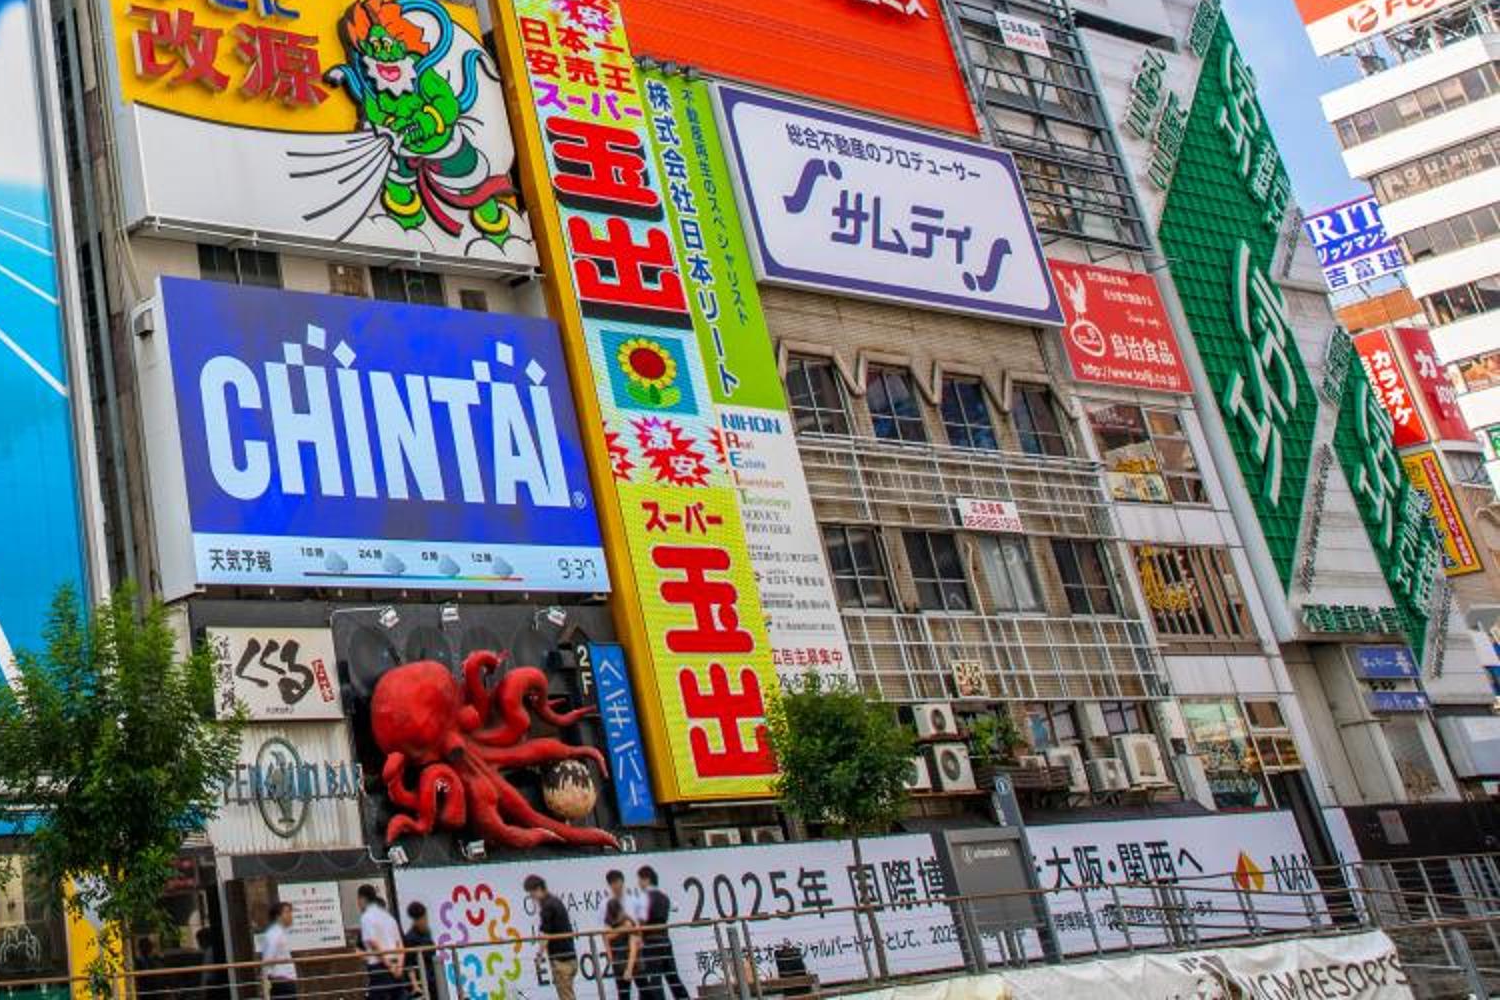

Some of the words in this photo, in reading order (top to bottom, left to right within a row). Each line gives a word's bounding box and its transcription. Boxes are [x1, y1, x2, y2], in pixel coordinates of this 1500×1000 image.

[126, 4, 332, 108] 改源
[520, 15, 626, 53] 日本一
[525, 48, 637, 95] 安売王
[532, 79, 644, 122] スーパー
[785, 121, 982, 184] 総合不動産のプロデューサー
[645, 79, 741, 400] 株式会社日本リート
[830, 188, 974, 268] サムティ
[199, 322, 572, 509] CHINTAI
[1371, 350, 1413, 425] カラオケ
[720, 412, 783, 435] NIHON
[641, 501, 724, 536] スーパー
[207, 546, 275, 574] 天気予報
[235, 637, 315, 705] くくる
[682, 866, 835, 924] 2025年
